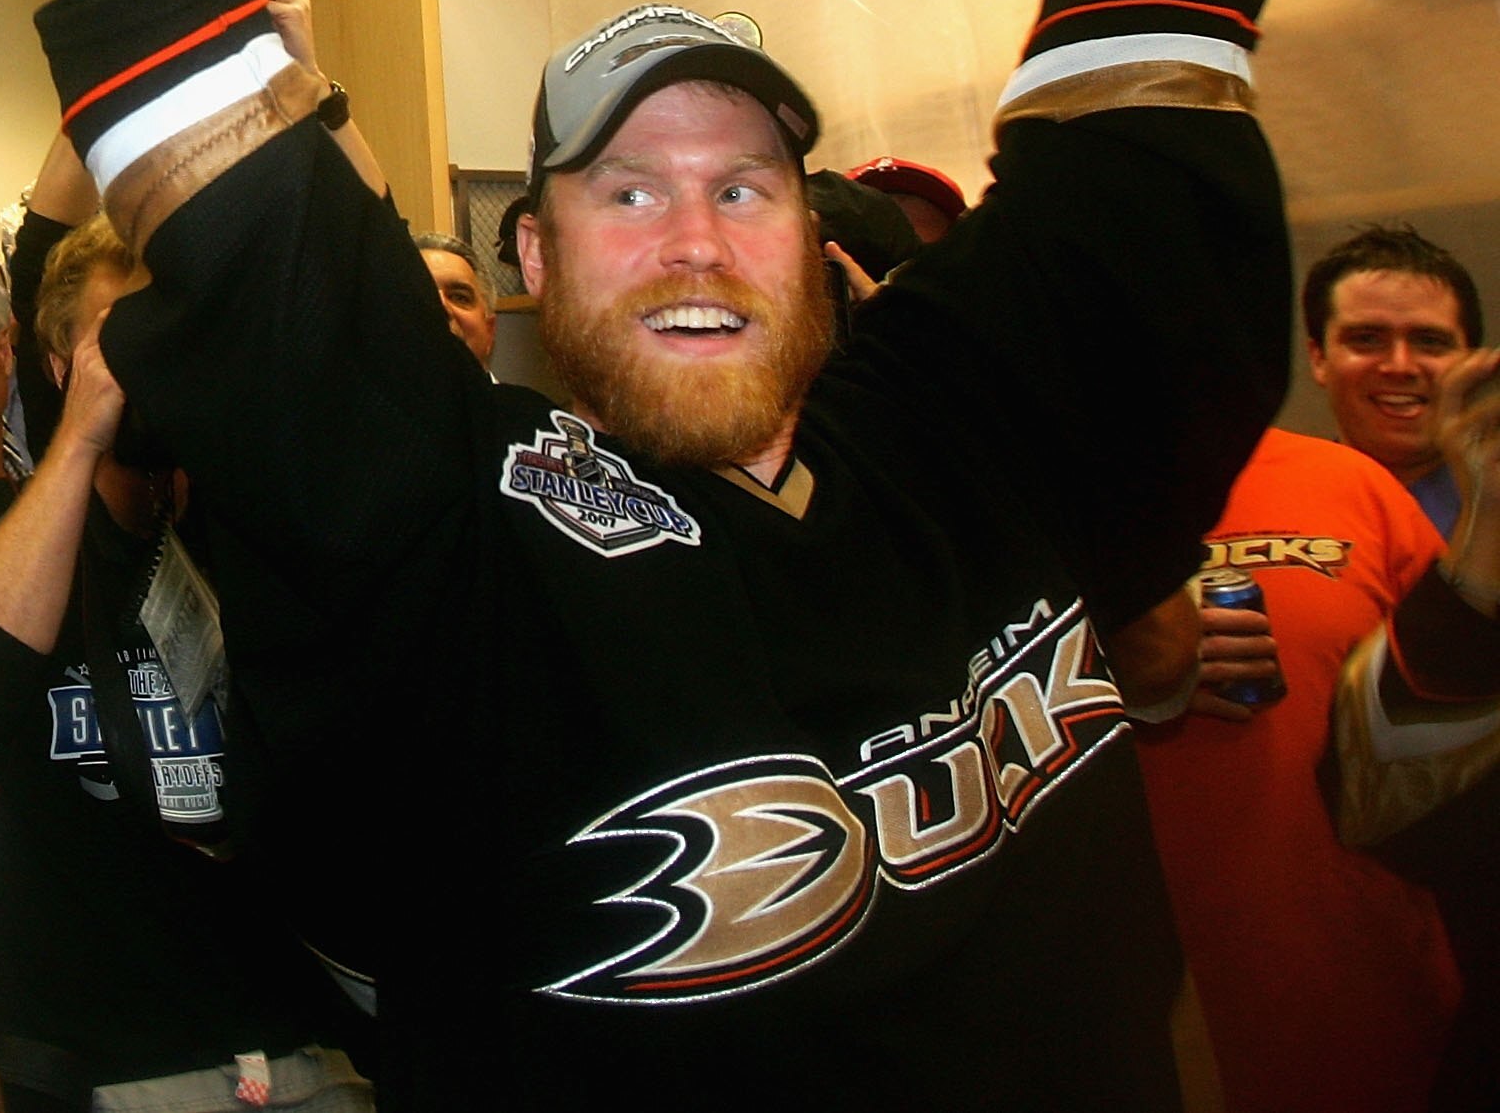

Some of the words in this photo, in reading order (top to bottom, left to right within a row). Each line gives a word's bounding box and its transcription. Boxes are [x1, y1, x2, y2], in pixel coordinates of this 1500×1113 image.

[511, 464, 627, 518] STANLEY
[625, 495, 692, 535] CUP
[578, 509, 617, 528] 2007
[1201, 538, 1346, 573] UCKS
[127, 668, 157, 695] THE
[151, 762, 223, 788] LAYOFFS
